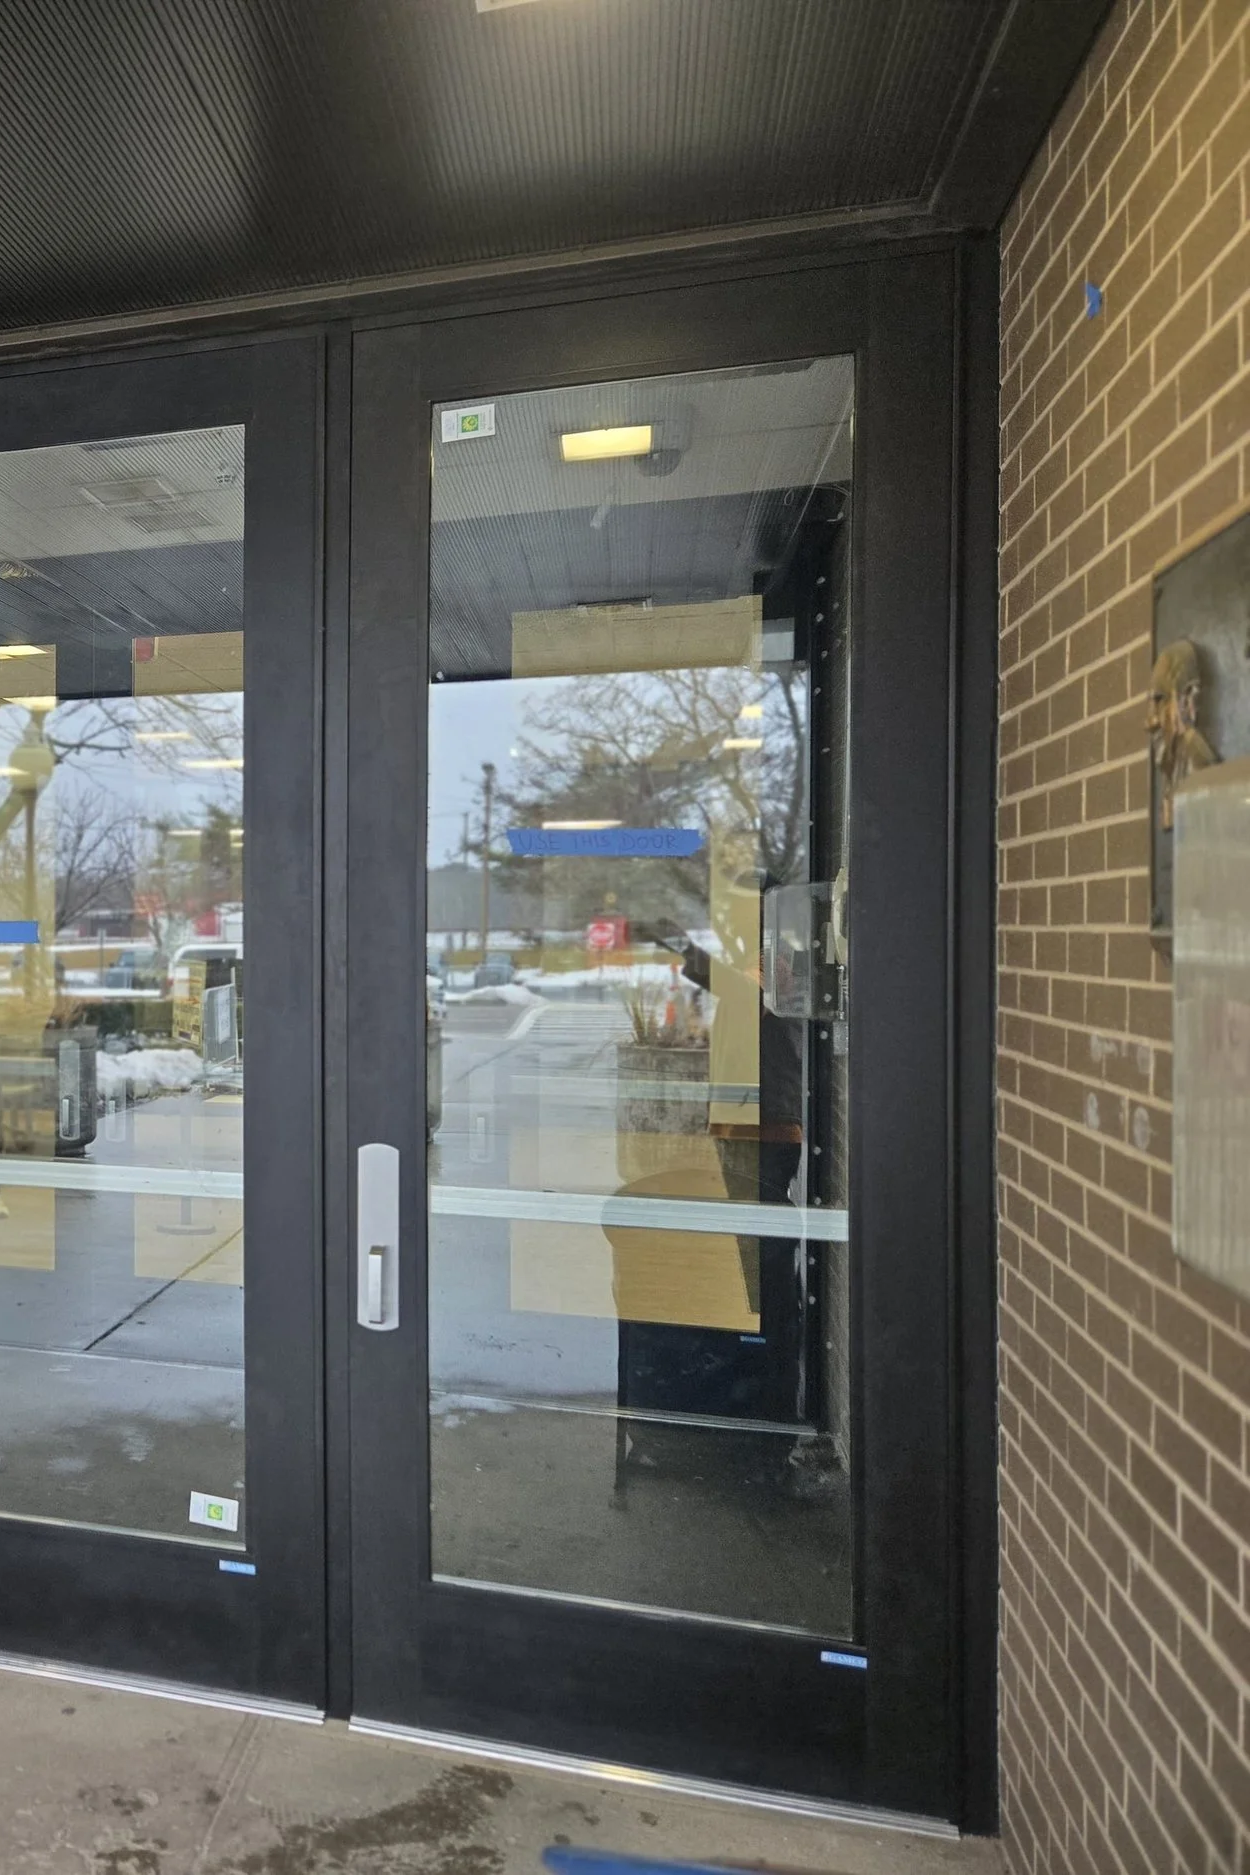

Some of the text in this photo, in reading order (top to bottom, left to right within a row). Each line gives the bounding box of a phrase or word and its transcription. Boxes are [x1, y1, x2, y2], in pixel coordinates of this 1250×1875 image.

[517, 832, 680, 851] USE THIS DOOR
